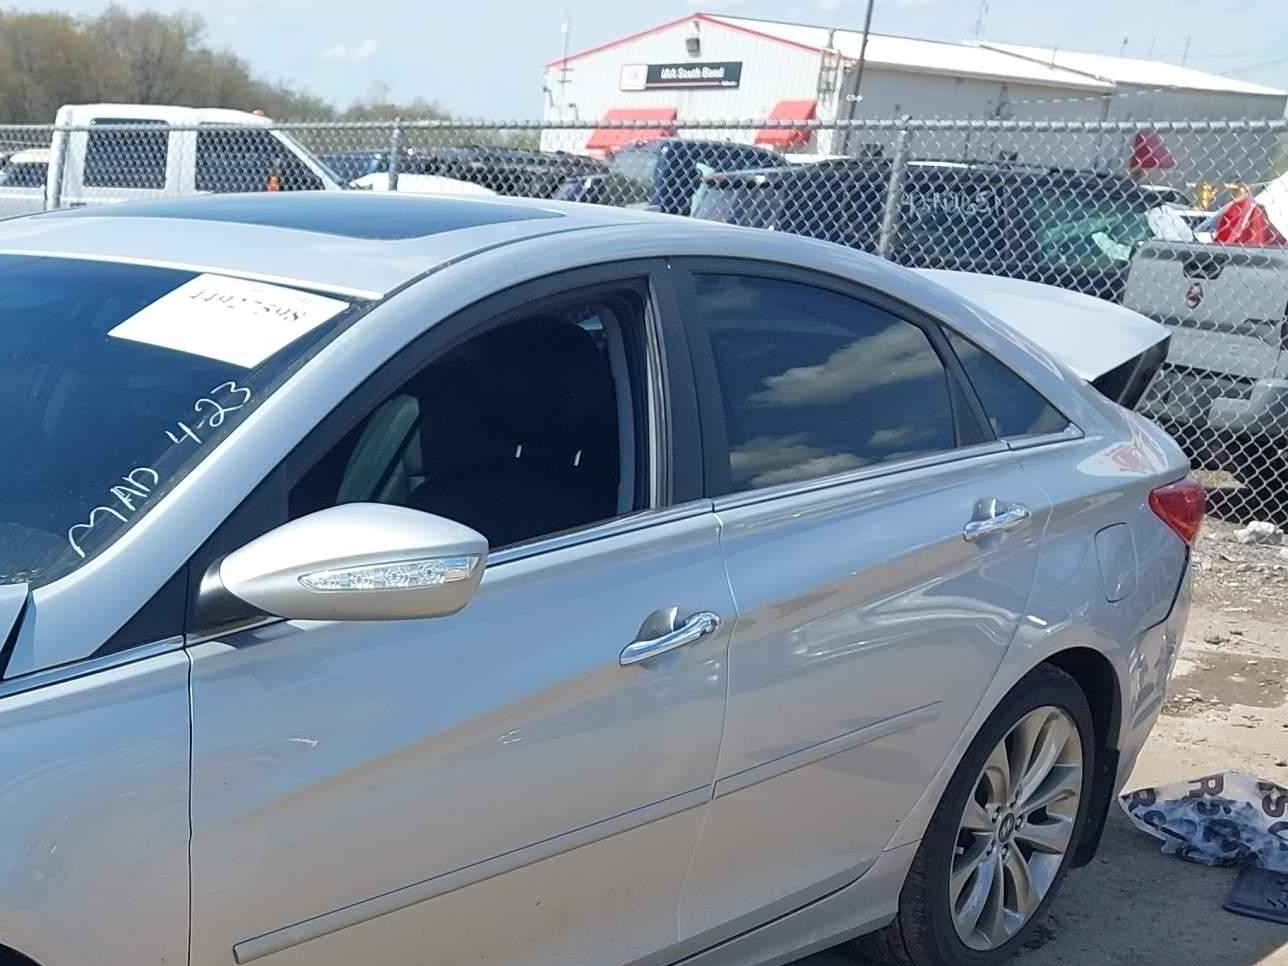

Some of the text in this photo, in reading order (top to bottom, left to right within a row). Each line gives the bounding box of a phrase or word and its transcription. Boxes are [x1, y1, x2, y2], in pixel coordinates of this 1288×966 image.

[677, 67, 702, 79] South
[701, 66, 725, 78] Bend
[68, 381, 251, 558] MAD 4-23
